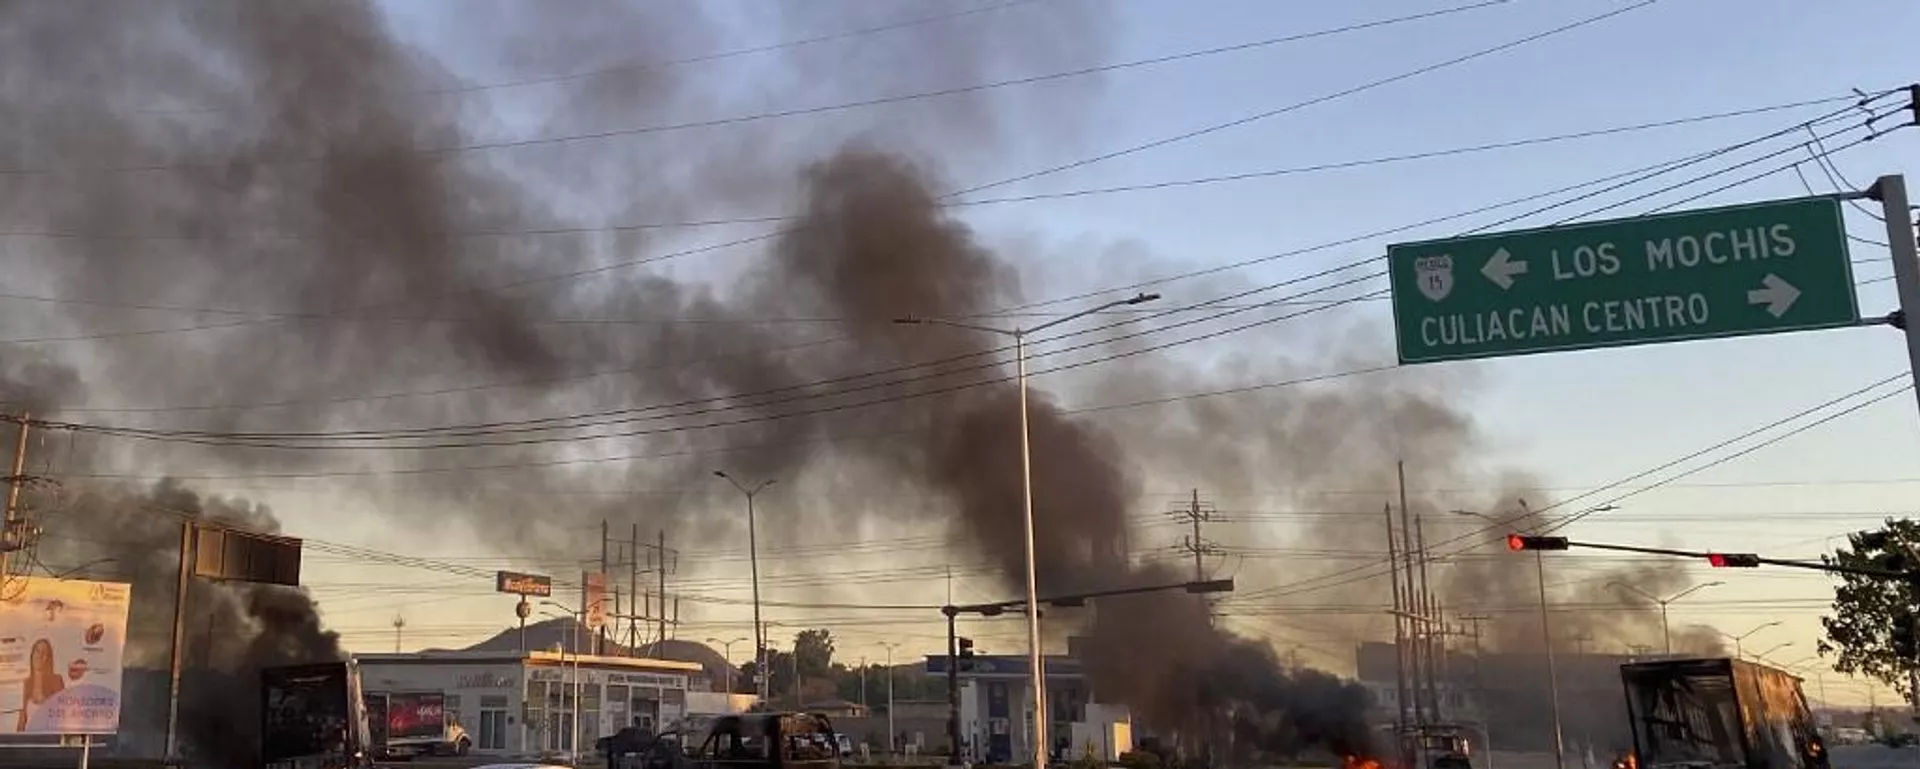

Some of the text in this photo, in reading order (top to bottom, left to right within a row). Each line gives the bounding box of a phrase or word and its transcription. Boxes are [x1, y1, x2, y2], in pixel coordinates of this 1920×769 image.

[1551, 223, 1796, 280] LOS MOCHIS
[1428, 275, 1443, 290] 15
[1421, 293, 1709, 347] CULIACAN CENTRO
